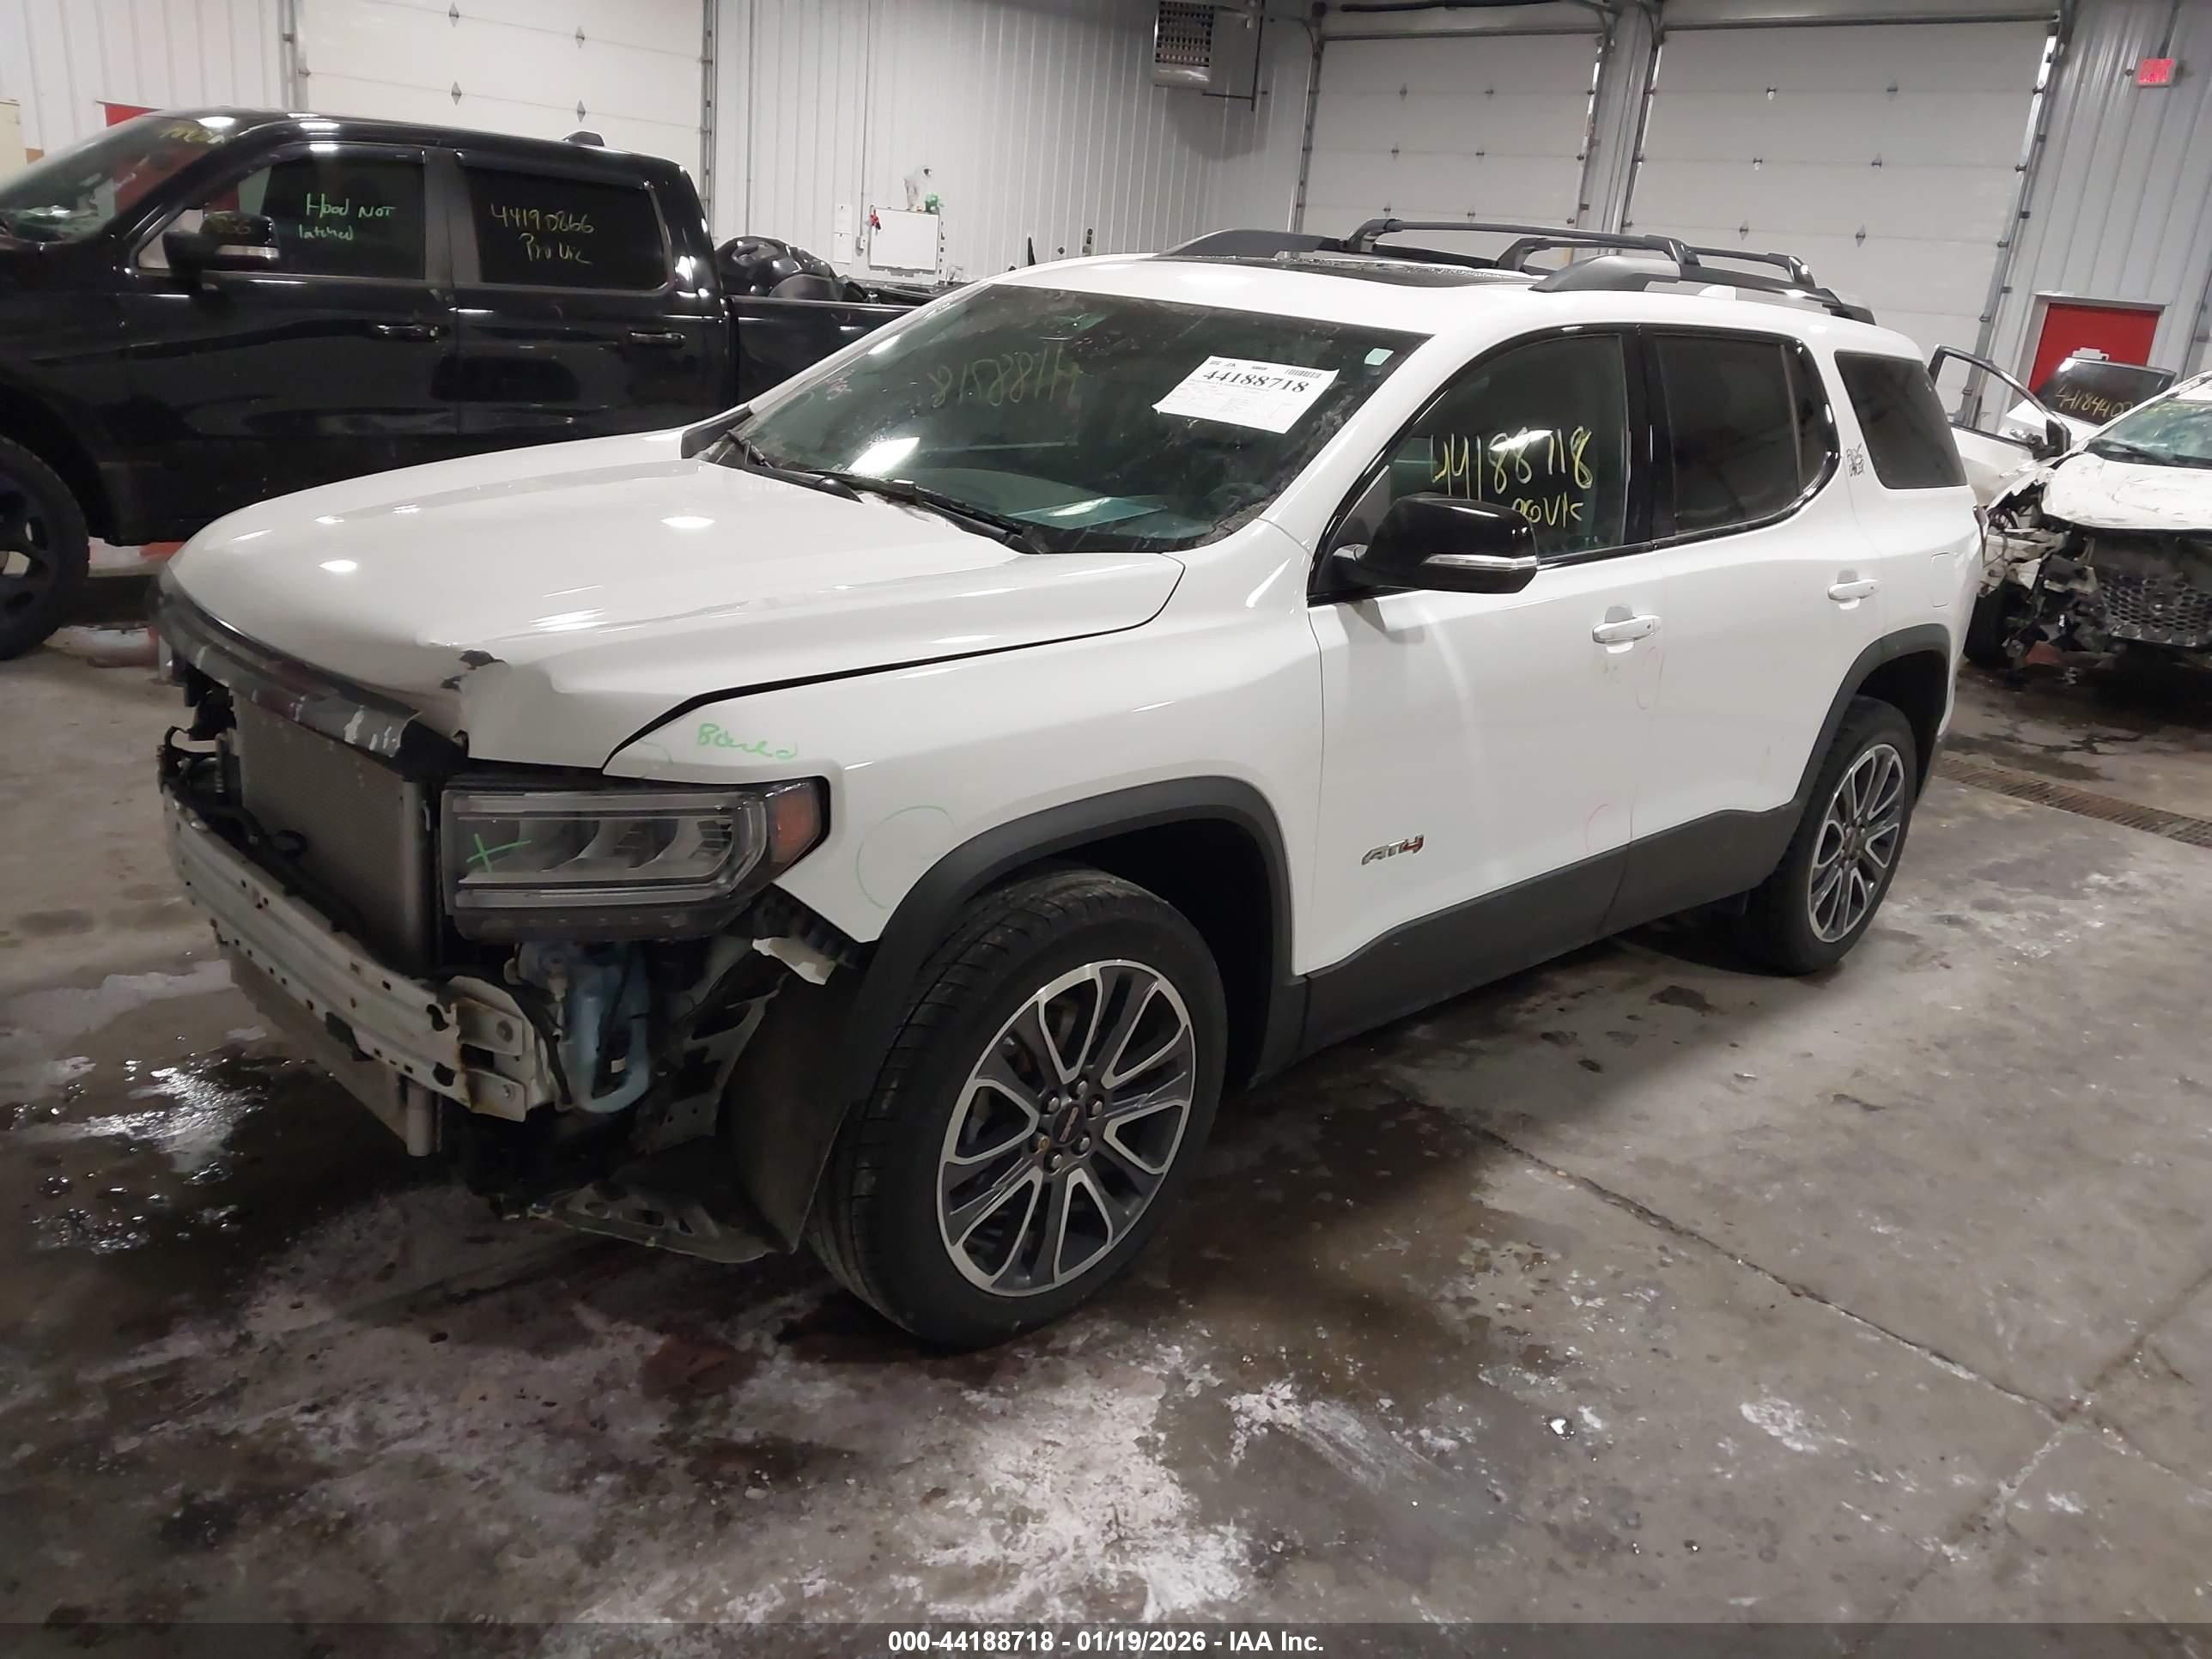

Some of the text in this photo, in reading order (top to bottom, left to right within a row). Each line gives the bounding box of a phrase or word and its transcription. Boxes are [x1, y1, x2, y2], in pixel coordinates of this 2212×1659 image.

[305, 193, 396, 219] Hood NOT
[299, 224, 354, 240] latched
[1203, 370, 1310, 393] 44188718
[1361, 834, 1425, 866] AT4
